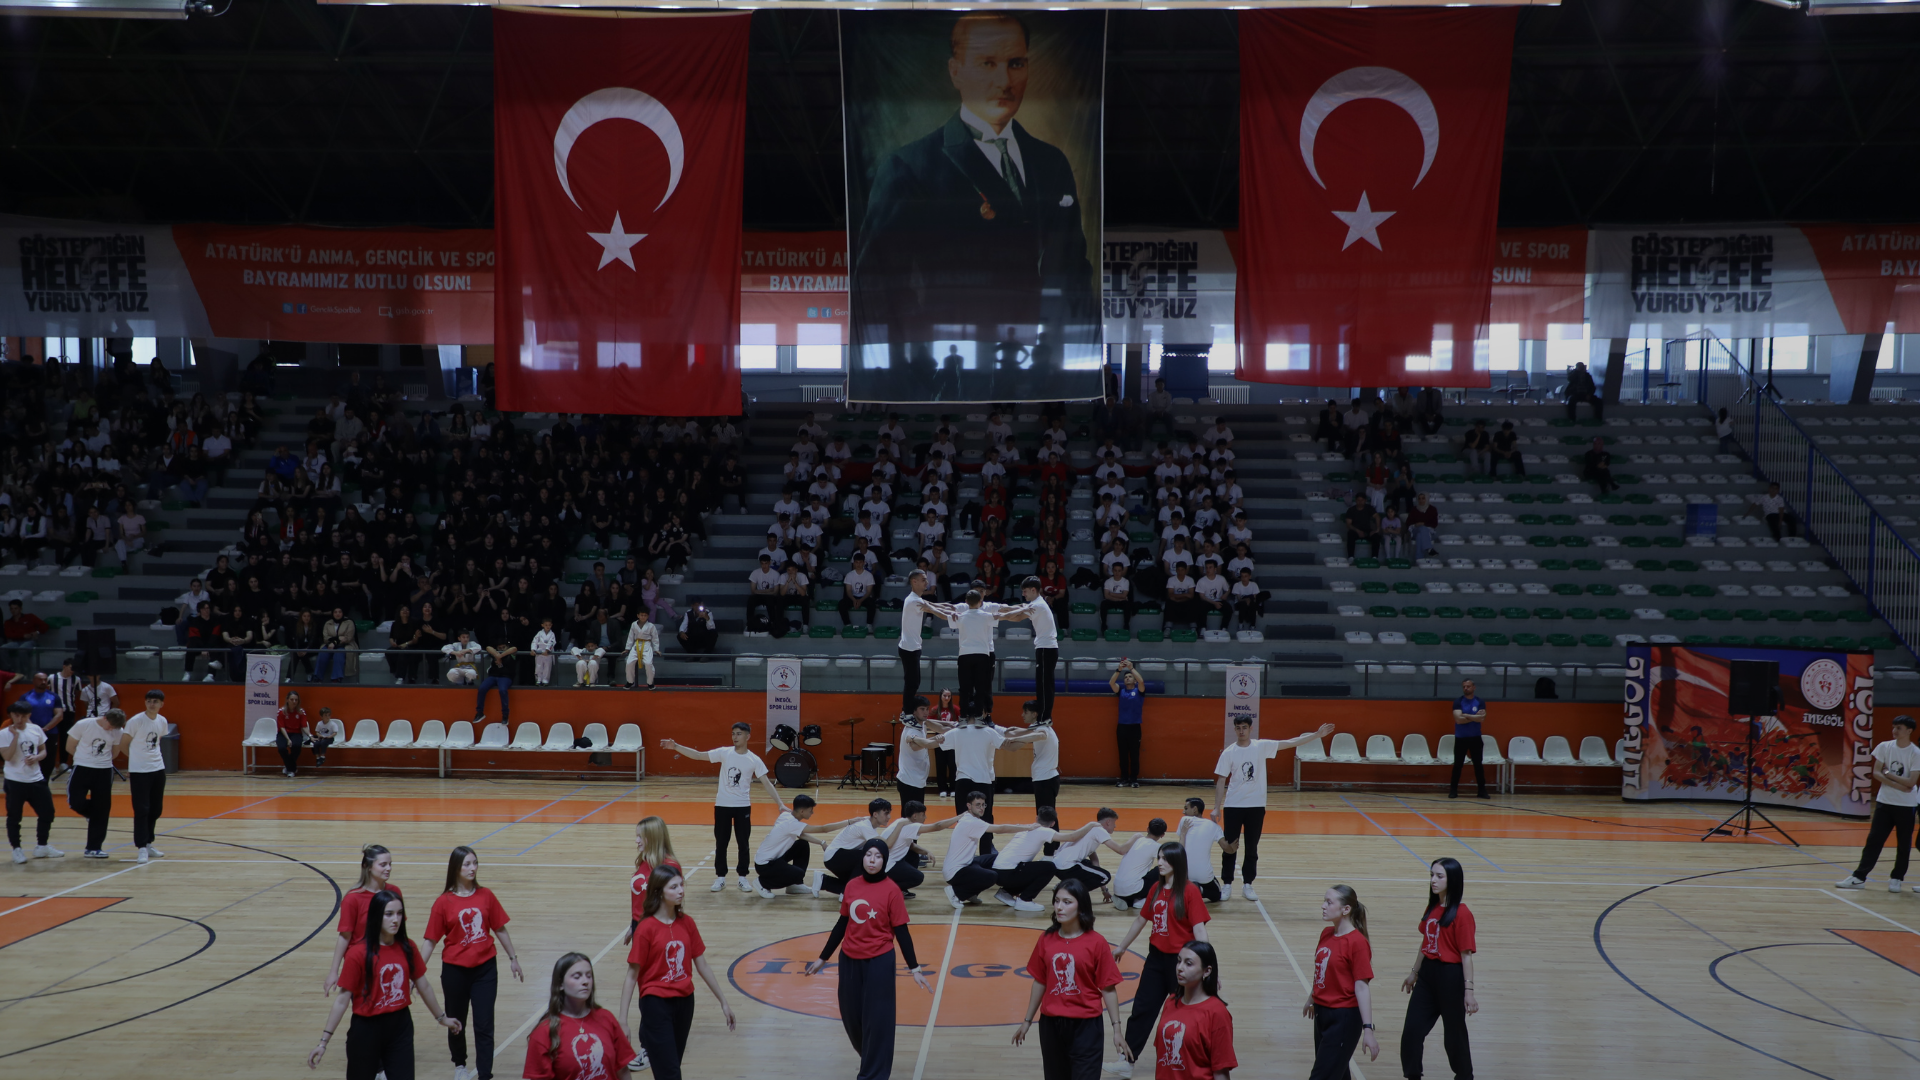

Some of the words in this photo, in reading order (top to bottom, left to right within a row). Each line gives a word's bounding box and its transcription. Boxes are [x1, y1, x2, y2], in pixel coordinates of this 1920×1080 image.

[308, 250, 360, 267] ANMA,
[366, 247, 434, 269] GENÇLİK
[440, 251, 460, 267] VE
[1500, 242, 1521, 258] VE
[1527, 243, 1570, 259] SPOR
[21, 256, 148, 291] HEDEFE
[1631, 255, 1773, 291] HEDEFE
[1880, 259, 1920, 276] BAY
[243, 270, 349, 289] BAYRAMIMIZ
[354, 274, 408, 290] KUTLU
[413, 275, 472, 291] OLSUN!
[24, 291, 149, 312] YÜRÜYORUZ
[1631, 291, 1773, 313] YÜRÜYORUZ
